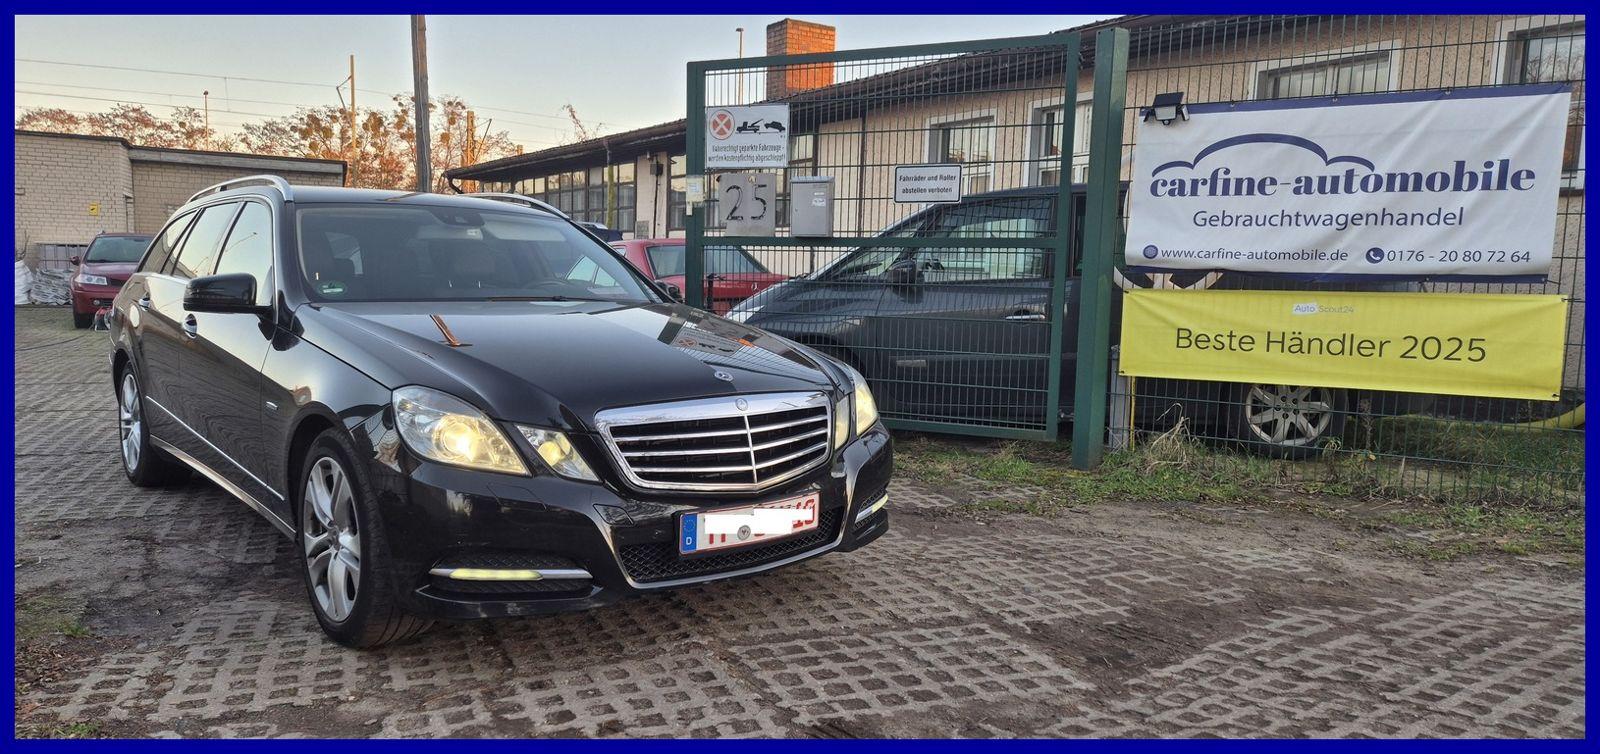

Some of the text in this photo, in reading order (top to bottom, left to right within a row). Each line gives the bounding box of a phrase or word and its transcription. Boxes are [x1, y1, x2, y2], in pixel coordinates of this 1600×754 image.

[739, 144, 758, 153] geparkte
[759, 144, 781, 153] Fahrzeuge
[708, 154, 723, 162] werden
[724, 153, 755, 163] kostenpflichtig
[899, 174, 927, 182] Fahrräder
[1150, 159, 1536, 198] carfine-automobile
[725, 184, 767, 220] 25
[1193, 207, 1464, 231] Gebrauchtwagenhandel
[1161, 248, 1349, 262] www.carfine-automobile.de
[1387, 251, 1425, 262] 0176
[1438, 251, 1459, 262] 20
[1462, 251, 1482, 262] 80
[1487, 251, 1507, 262] 72
[1510, 251, 1531, 262] 64
[1176, 327, 1487, 362] Beste Händler 2025
[686, 537, 692, 545] D
